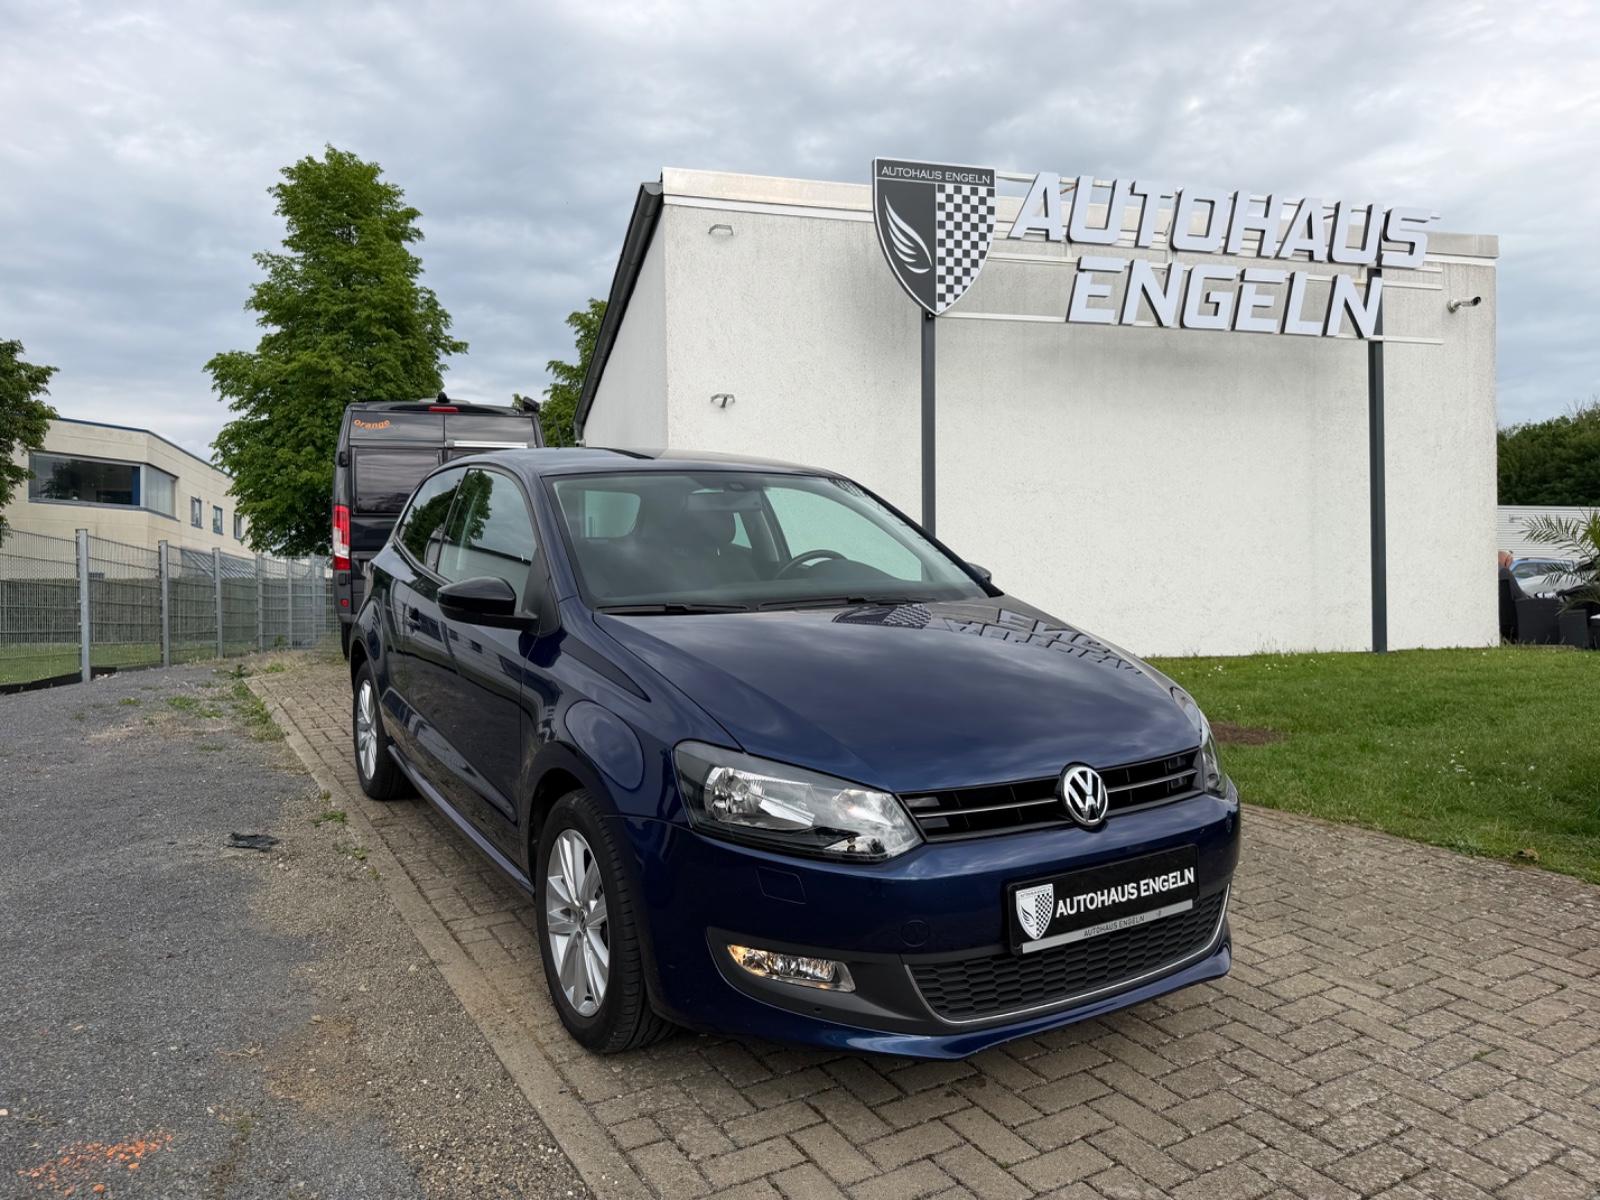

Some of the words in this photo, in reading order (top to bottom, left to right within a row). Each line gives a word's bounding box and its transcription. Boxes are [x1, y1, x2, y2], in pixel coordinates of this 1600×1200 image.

[881, 165, 942, 180] AUTOHAUS
[945, 171, 991, 185] ENGELN
[1007, 171, 1434, 268] AUTOHAUS
[1066, 254, 1383, 338] ENGELN
[1056, 882, 1138, 918] AUTOHAUS
[1139, 866, 1195, 897] ENGELN
[1083, 921, 1118, 938] AUTOHAUS
[1119, 914, 1145, 929] ENGELN
